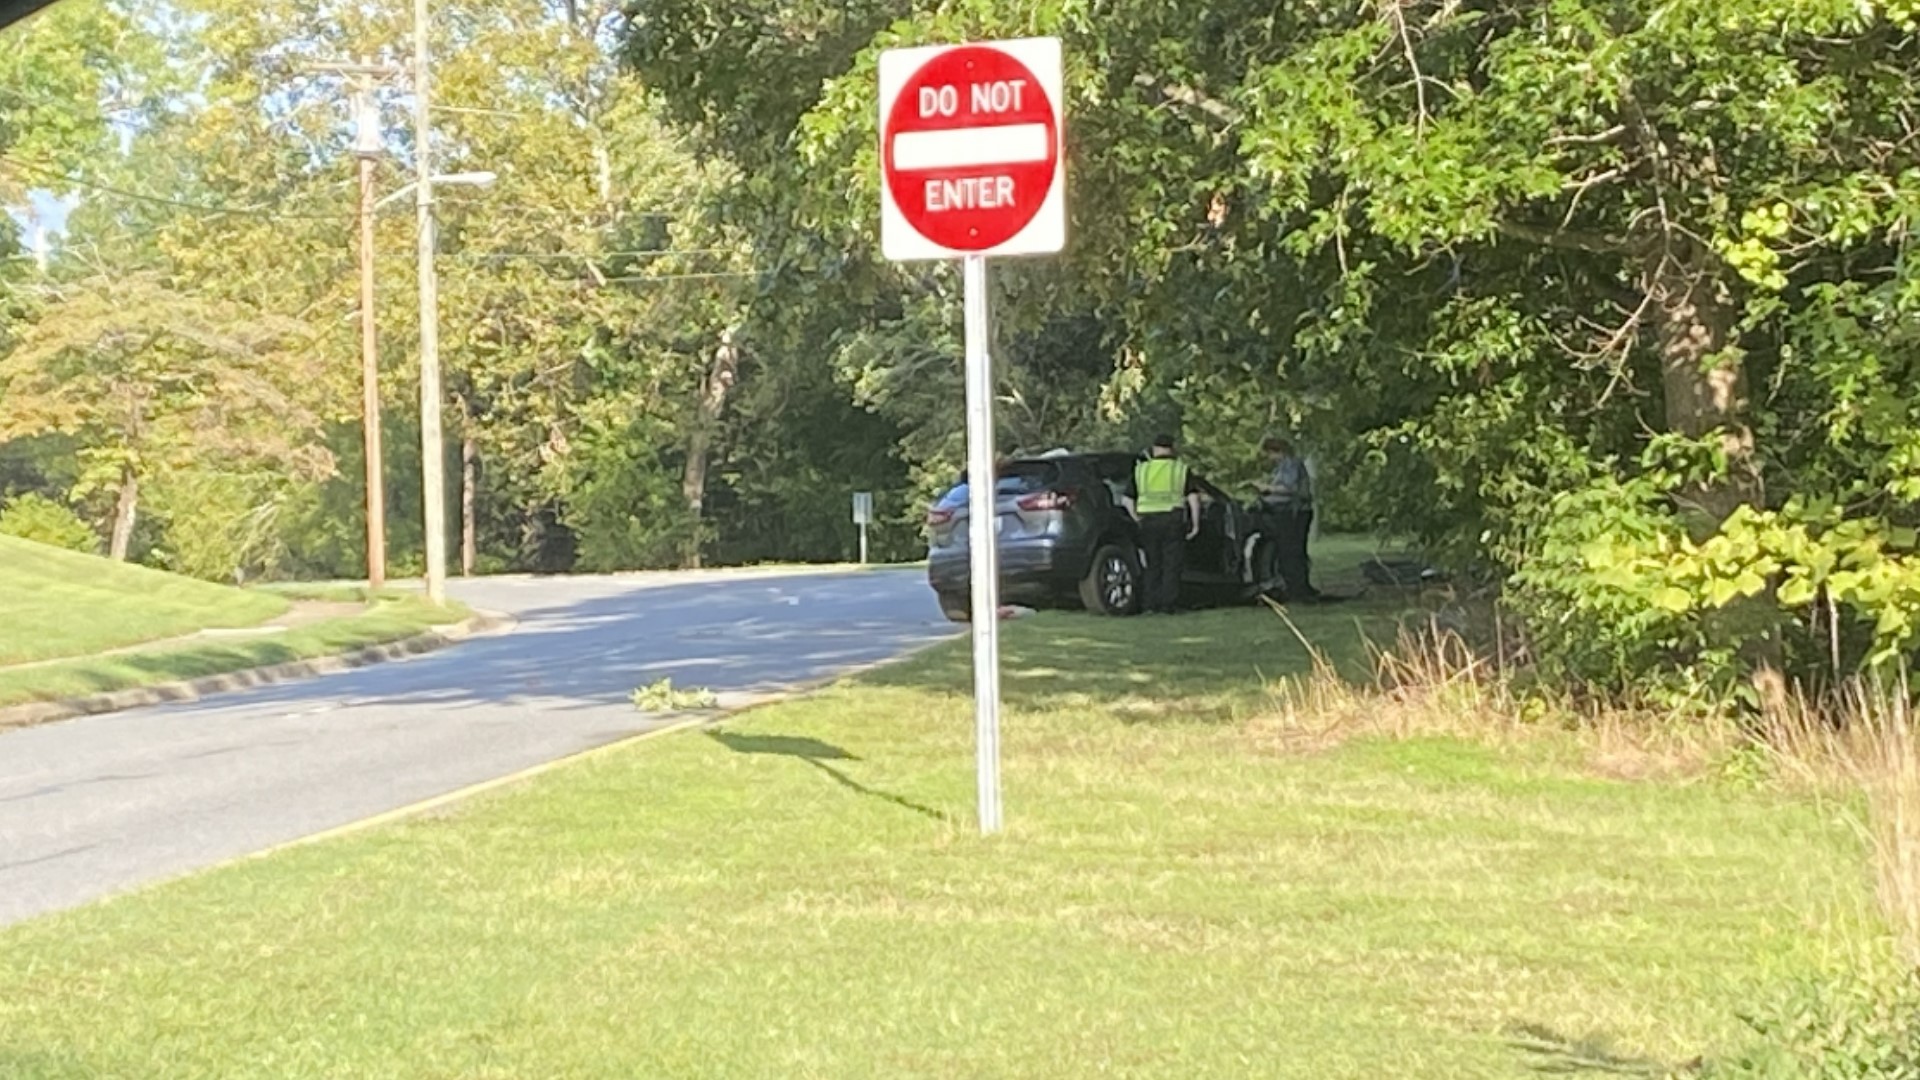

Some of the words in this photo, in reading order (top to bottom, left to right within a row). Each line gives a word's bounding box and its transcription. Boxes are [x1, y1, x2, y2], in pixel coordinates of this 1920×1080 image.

[919, 84, 958, 118] DO
[970, 79, 1027, 113] NOT
[925, 175, 1016, 212] ENTER
